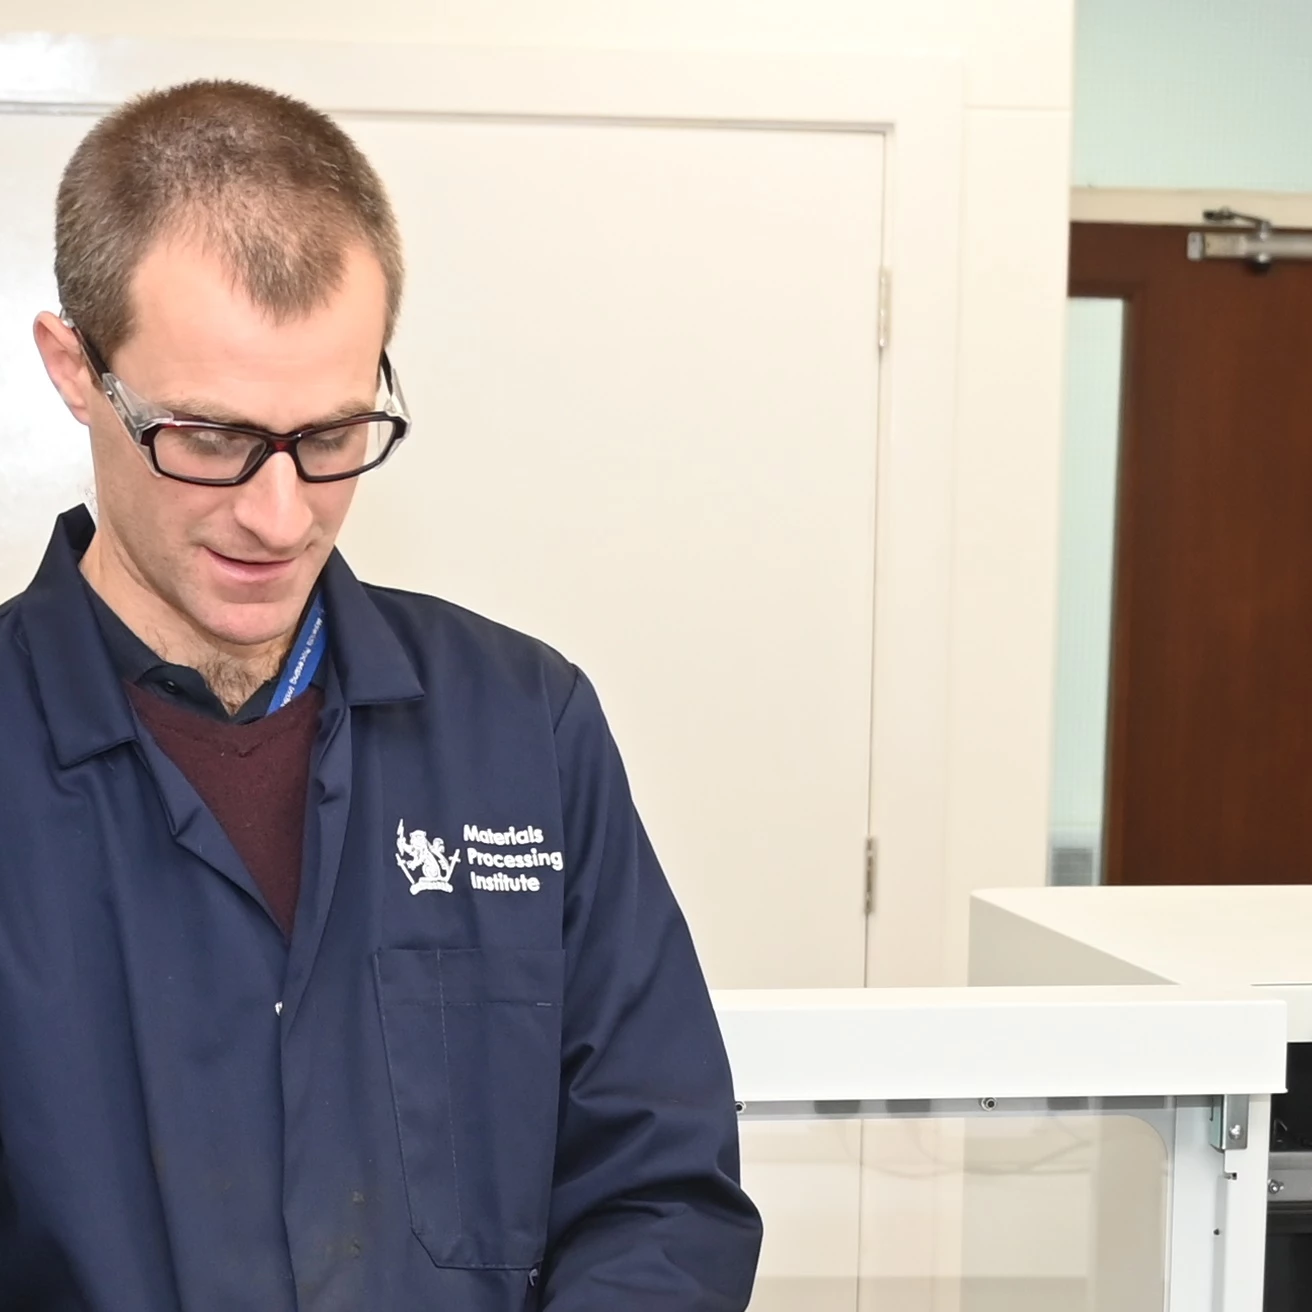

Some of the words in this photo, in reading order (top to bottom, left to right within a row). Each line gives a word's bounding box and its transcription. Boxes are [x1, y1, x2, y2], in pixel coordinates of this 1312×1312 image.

[463, 824, 544, 846] Materials
[467, 847, 563, 871] Processing
[470, 871, 540, 892] Institute
